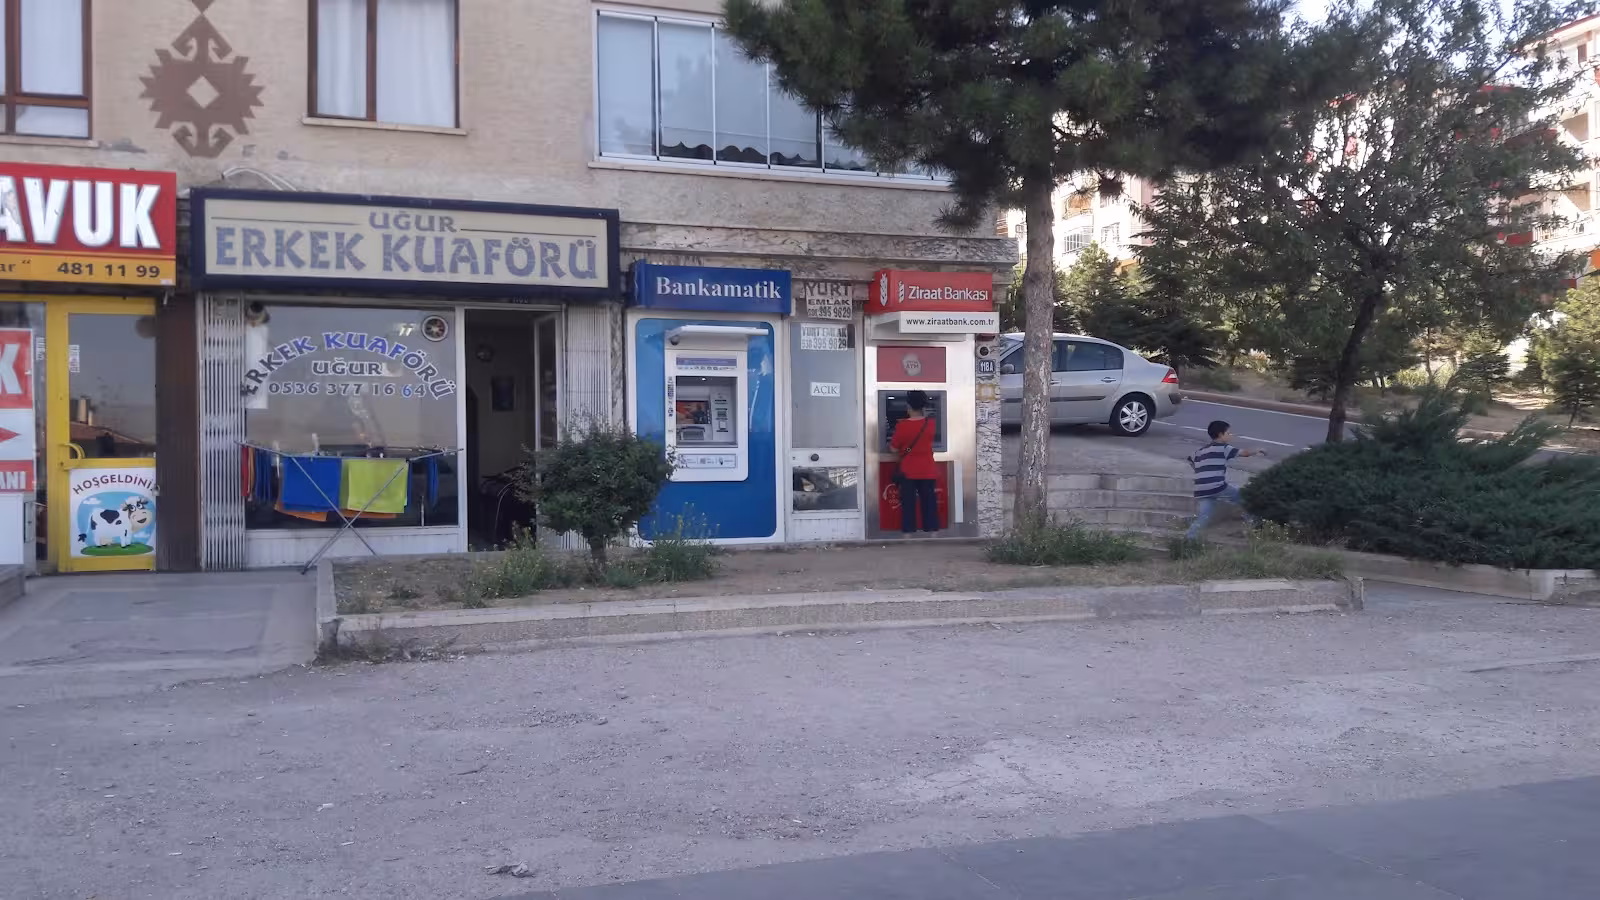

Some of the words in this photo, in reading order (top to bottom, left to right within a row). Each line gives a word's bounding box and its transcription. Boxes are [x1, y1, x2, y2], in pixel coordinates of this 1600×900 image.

[215, 225, 366, 272] ERKEK
[381, 233, 599, 279] KUAFÖRÜ
[57, 262, 94, 275] 481
[104, 264, 126, 276] 11
[136, 265, 160, 277] 99
[656, 276, 782, 298] Bankamatik
[805, 282, 851, 296] YURT
[908, 286, 942, 300] Ziraat
[944, 288, 989, 301] Bankası
[906, 317, 994, 327] www.ziraatbank.com.tr
[240, 335, 317, 397] ERKEK
[322, 331, 457, 400] KUAFÖRÜ
[312, 357, 383, 376] UĞUR
[980, 361, 994, 372] 118A
[268, 381, 319, 395] 0536
[327, 382, 363, 396] 377
[372, 383, 396, 396] 16
[402, 383, 427, 398] 64
[813, 385, 838, 396] AÇIK
[72, 474, 156, 494] HOŞGELDİNİ
